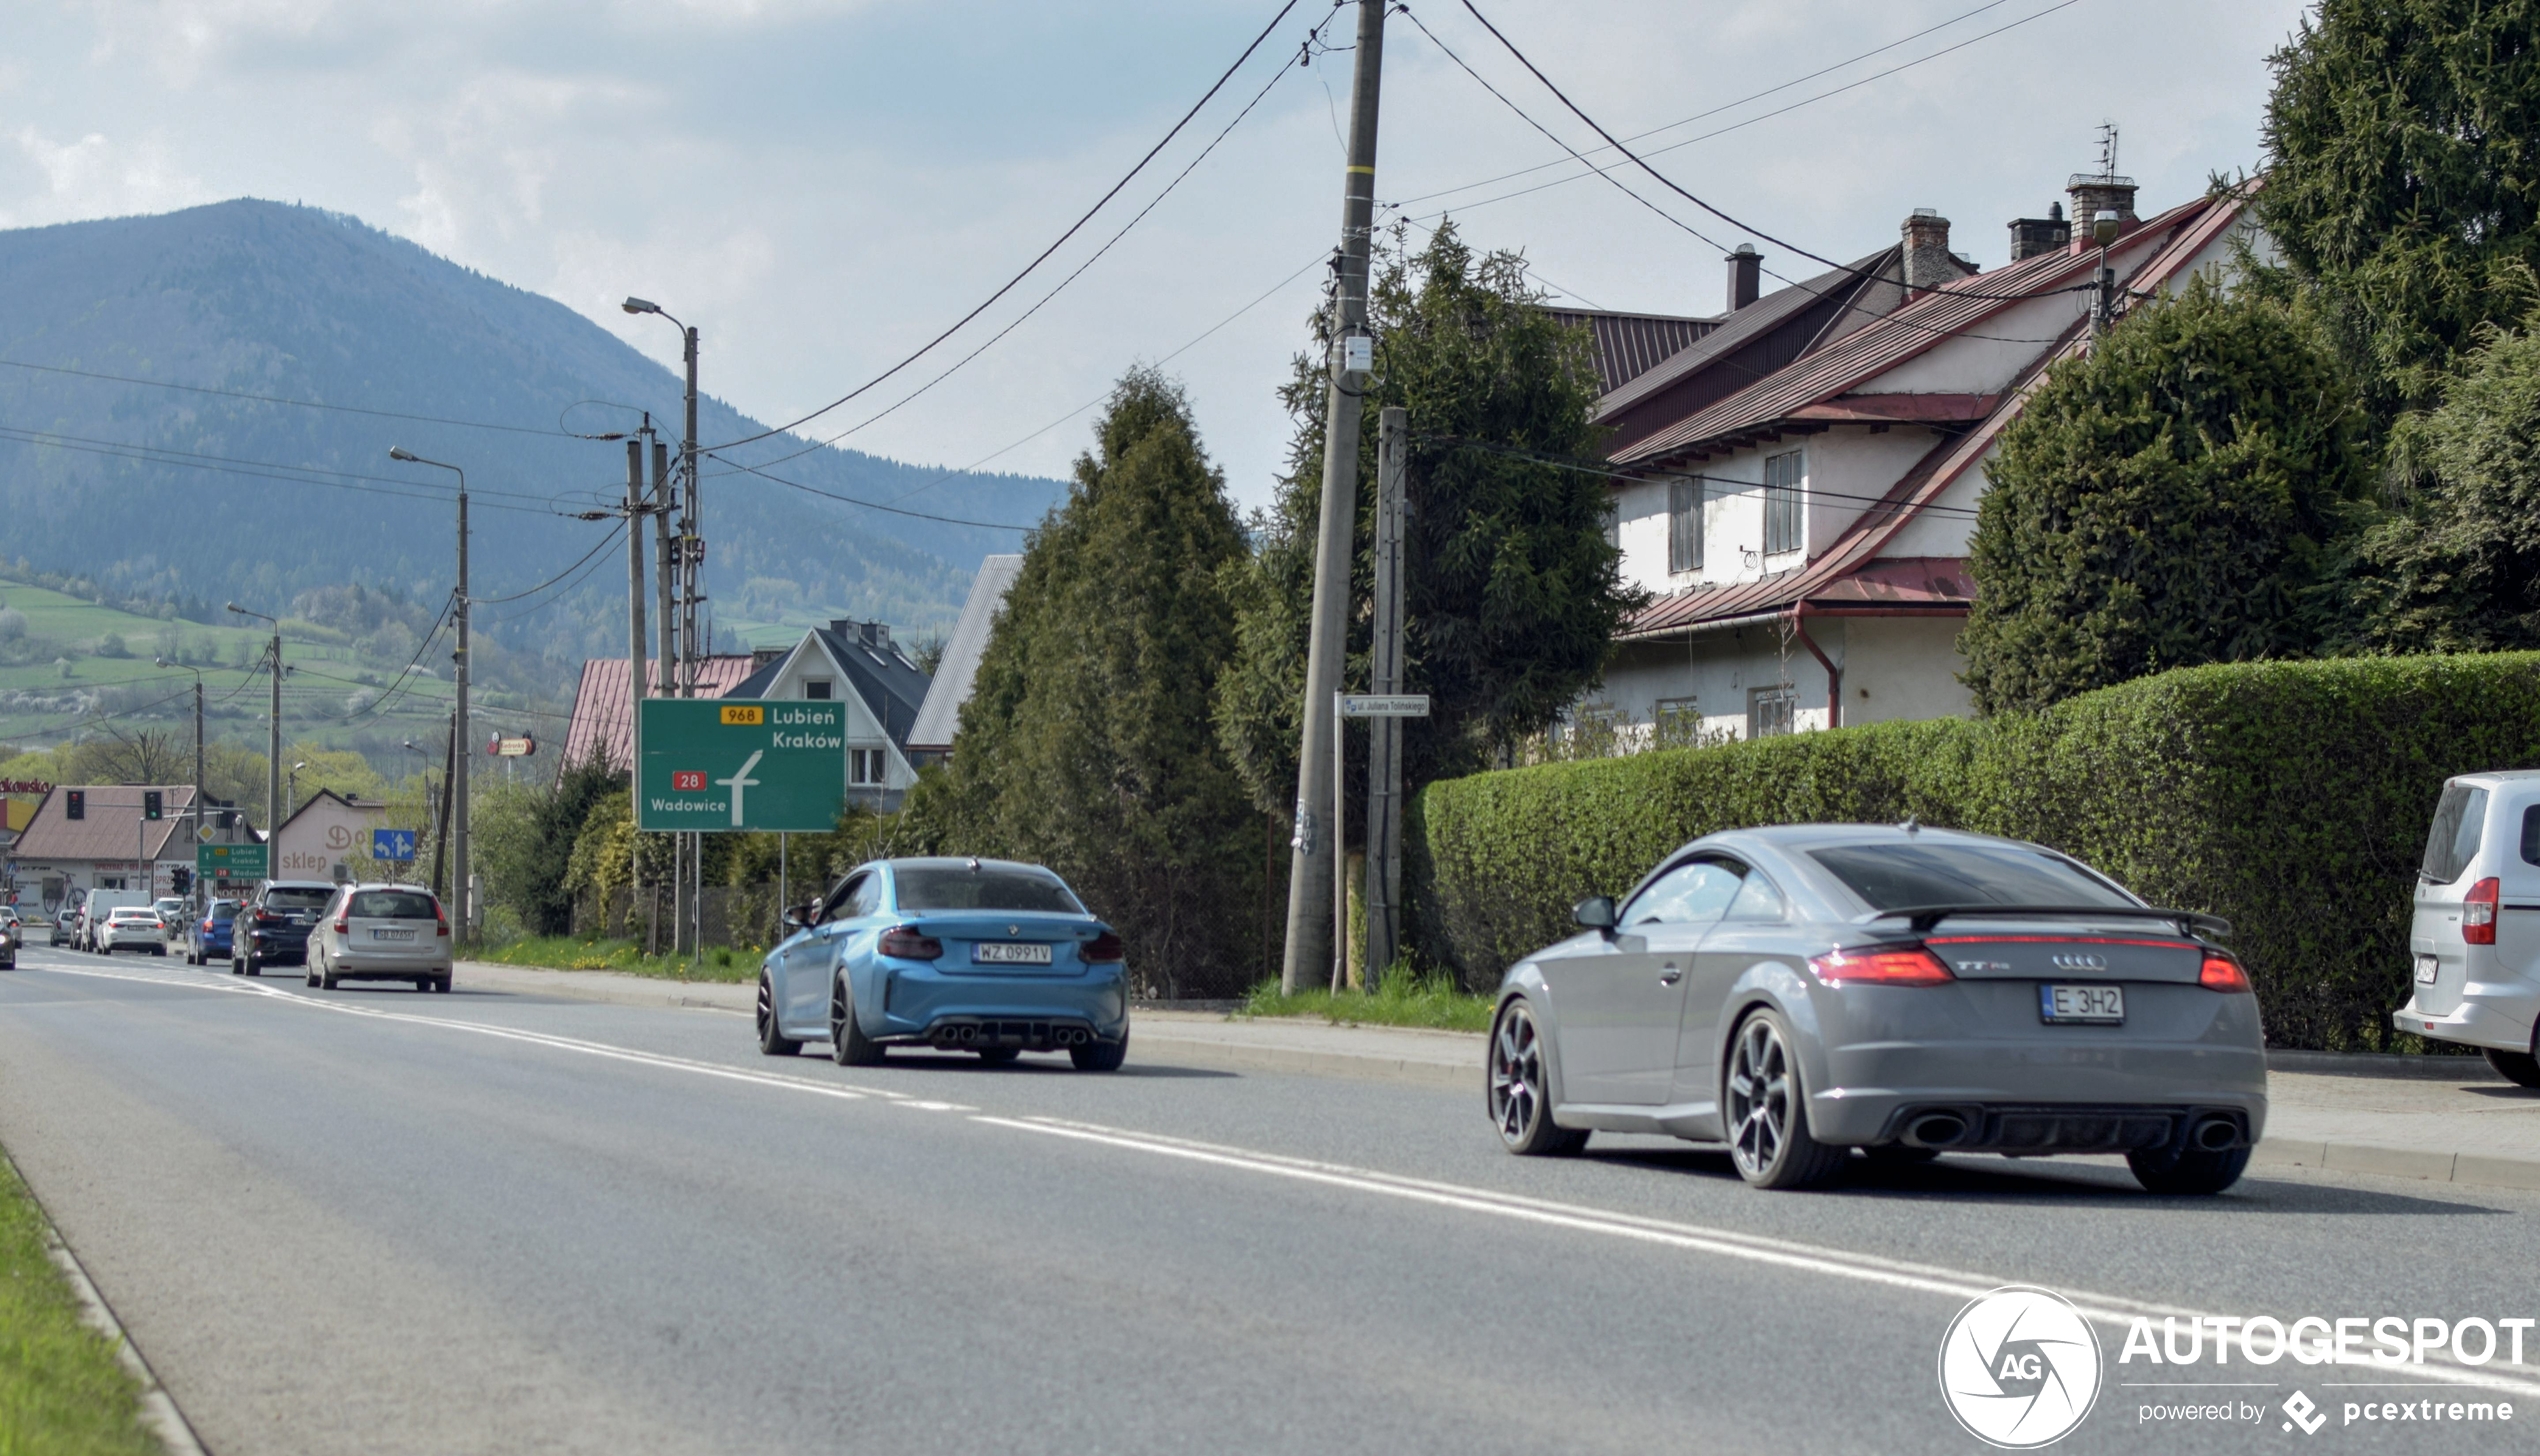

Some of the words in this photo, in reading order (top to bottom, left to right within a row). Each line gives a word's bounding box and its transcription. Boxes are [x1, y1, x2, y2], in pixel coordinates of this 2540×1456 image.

[1367, 701, 1389, 710] Juliana
[728, 709, 755, 722] 968
[773, 708, 835, 725] Lubień
[773, 731, 842, 749] Kraków
[681, 775, 699, 788] 28
[651, 798, 727, 812] Wadowice
[282, 852, 327, 873] sklep
[981, 945, 1001, 960] WZ
[1006, 945, 1049, 960] 0991V
[2055, 989, 2070, 1013] E
[2077, 989, 2119, 1014] 3H2
